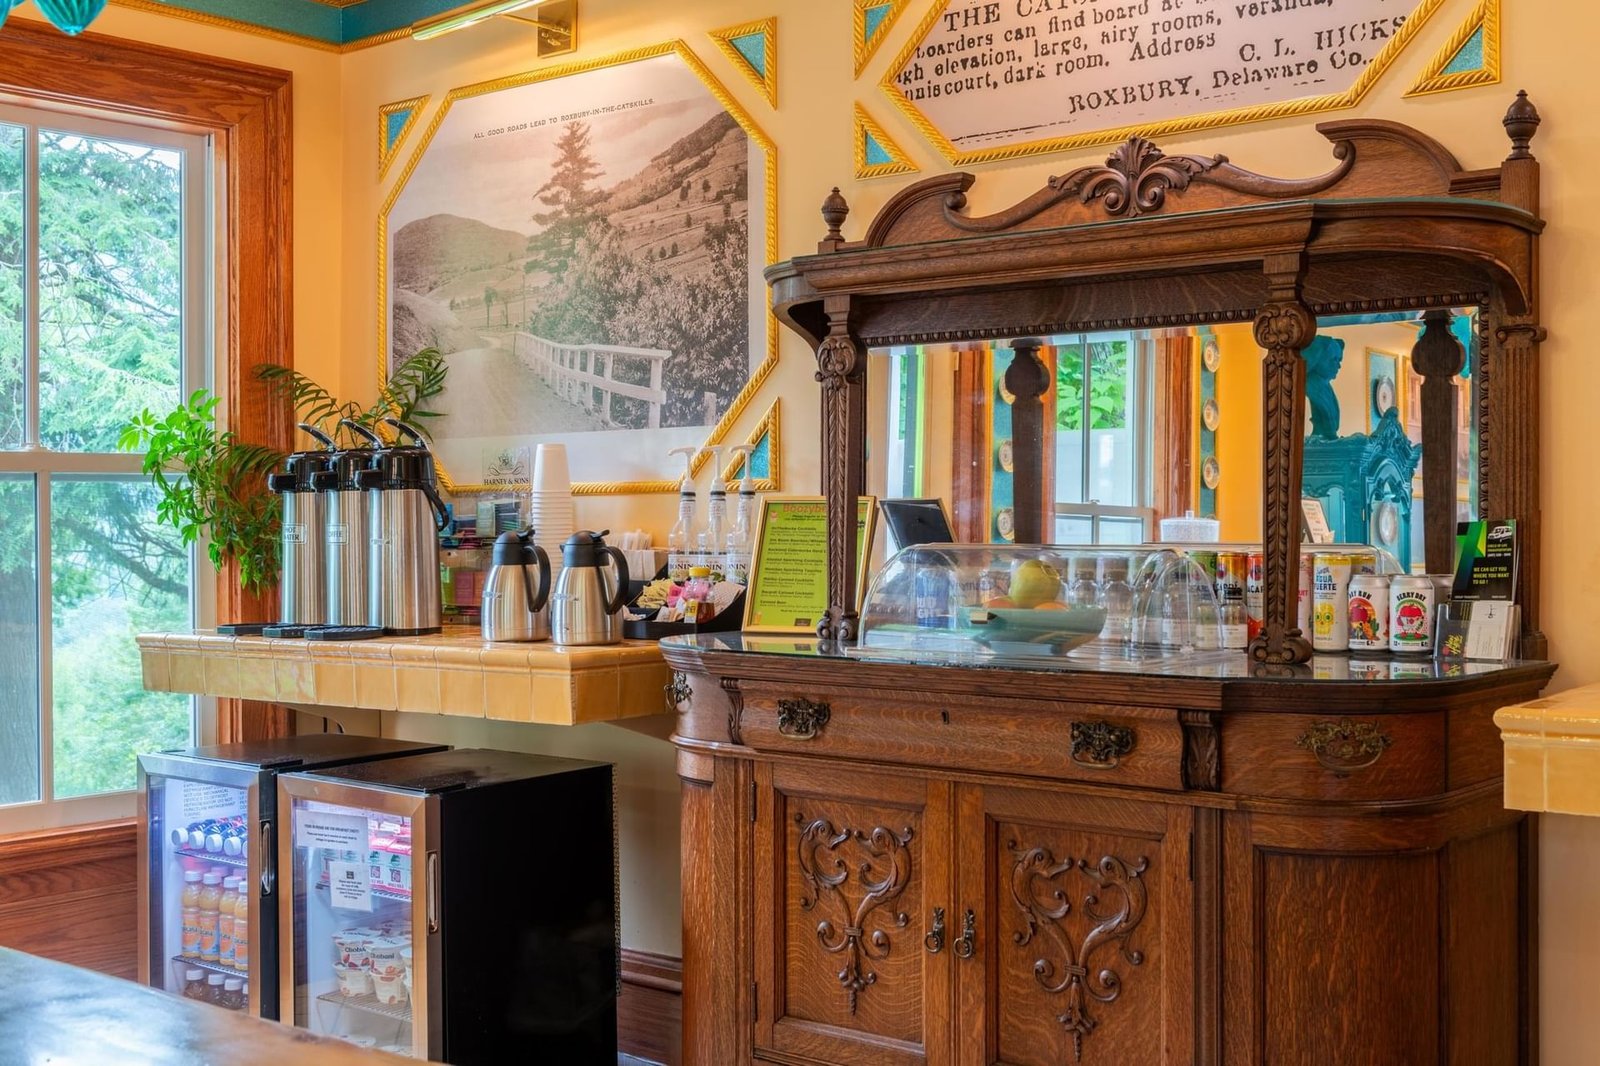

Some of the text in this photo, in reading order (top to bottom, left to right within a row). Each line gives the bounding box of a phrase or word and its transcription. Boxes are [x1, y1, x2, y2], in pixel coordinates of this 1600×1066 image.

[944, 3, 1000, 32] THE
[1004, 25, 1036, 42] can
[1049, 10, 1085, 35] find
[1093, 0, 1149, 25] board
[935, 48, 1022, 77] elevation,
[1034, 36, 1088, 58] large,
[1100, 25, 1139, 45] airy
[1152, 10, 1222, 35] rooms,
[1238, 43, 1261, 62] C.
[1274, 38, 1296, 57] L.
[944, 71, 999, 96] court,
[1004, 62, 1046, 84] dark
[1056, 53, 1110, 76] room.
[1129, 32, 1216, 61] Address
[1068, 76, 1200, 114] ROXBURY,
[1212, 59, 1319, 89] Delaware
[473, 132, 485, 140] ALL
[487, 128, 505, 137] GOOD
[507, 123, 528, 132] ROADS
[530, 119, 546, 128] LEAD
[483, 478, 507, 486] HARNEY
[514, 477, 529, 485] SONS
